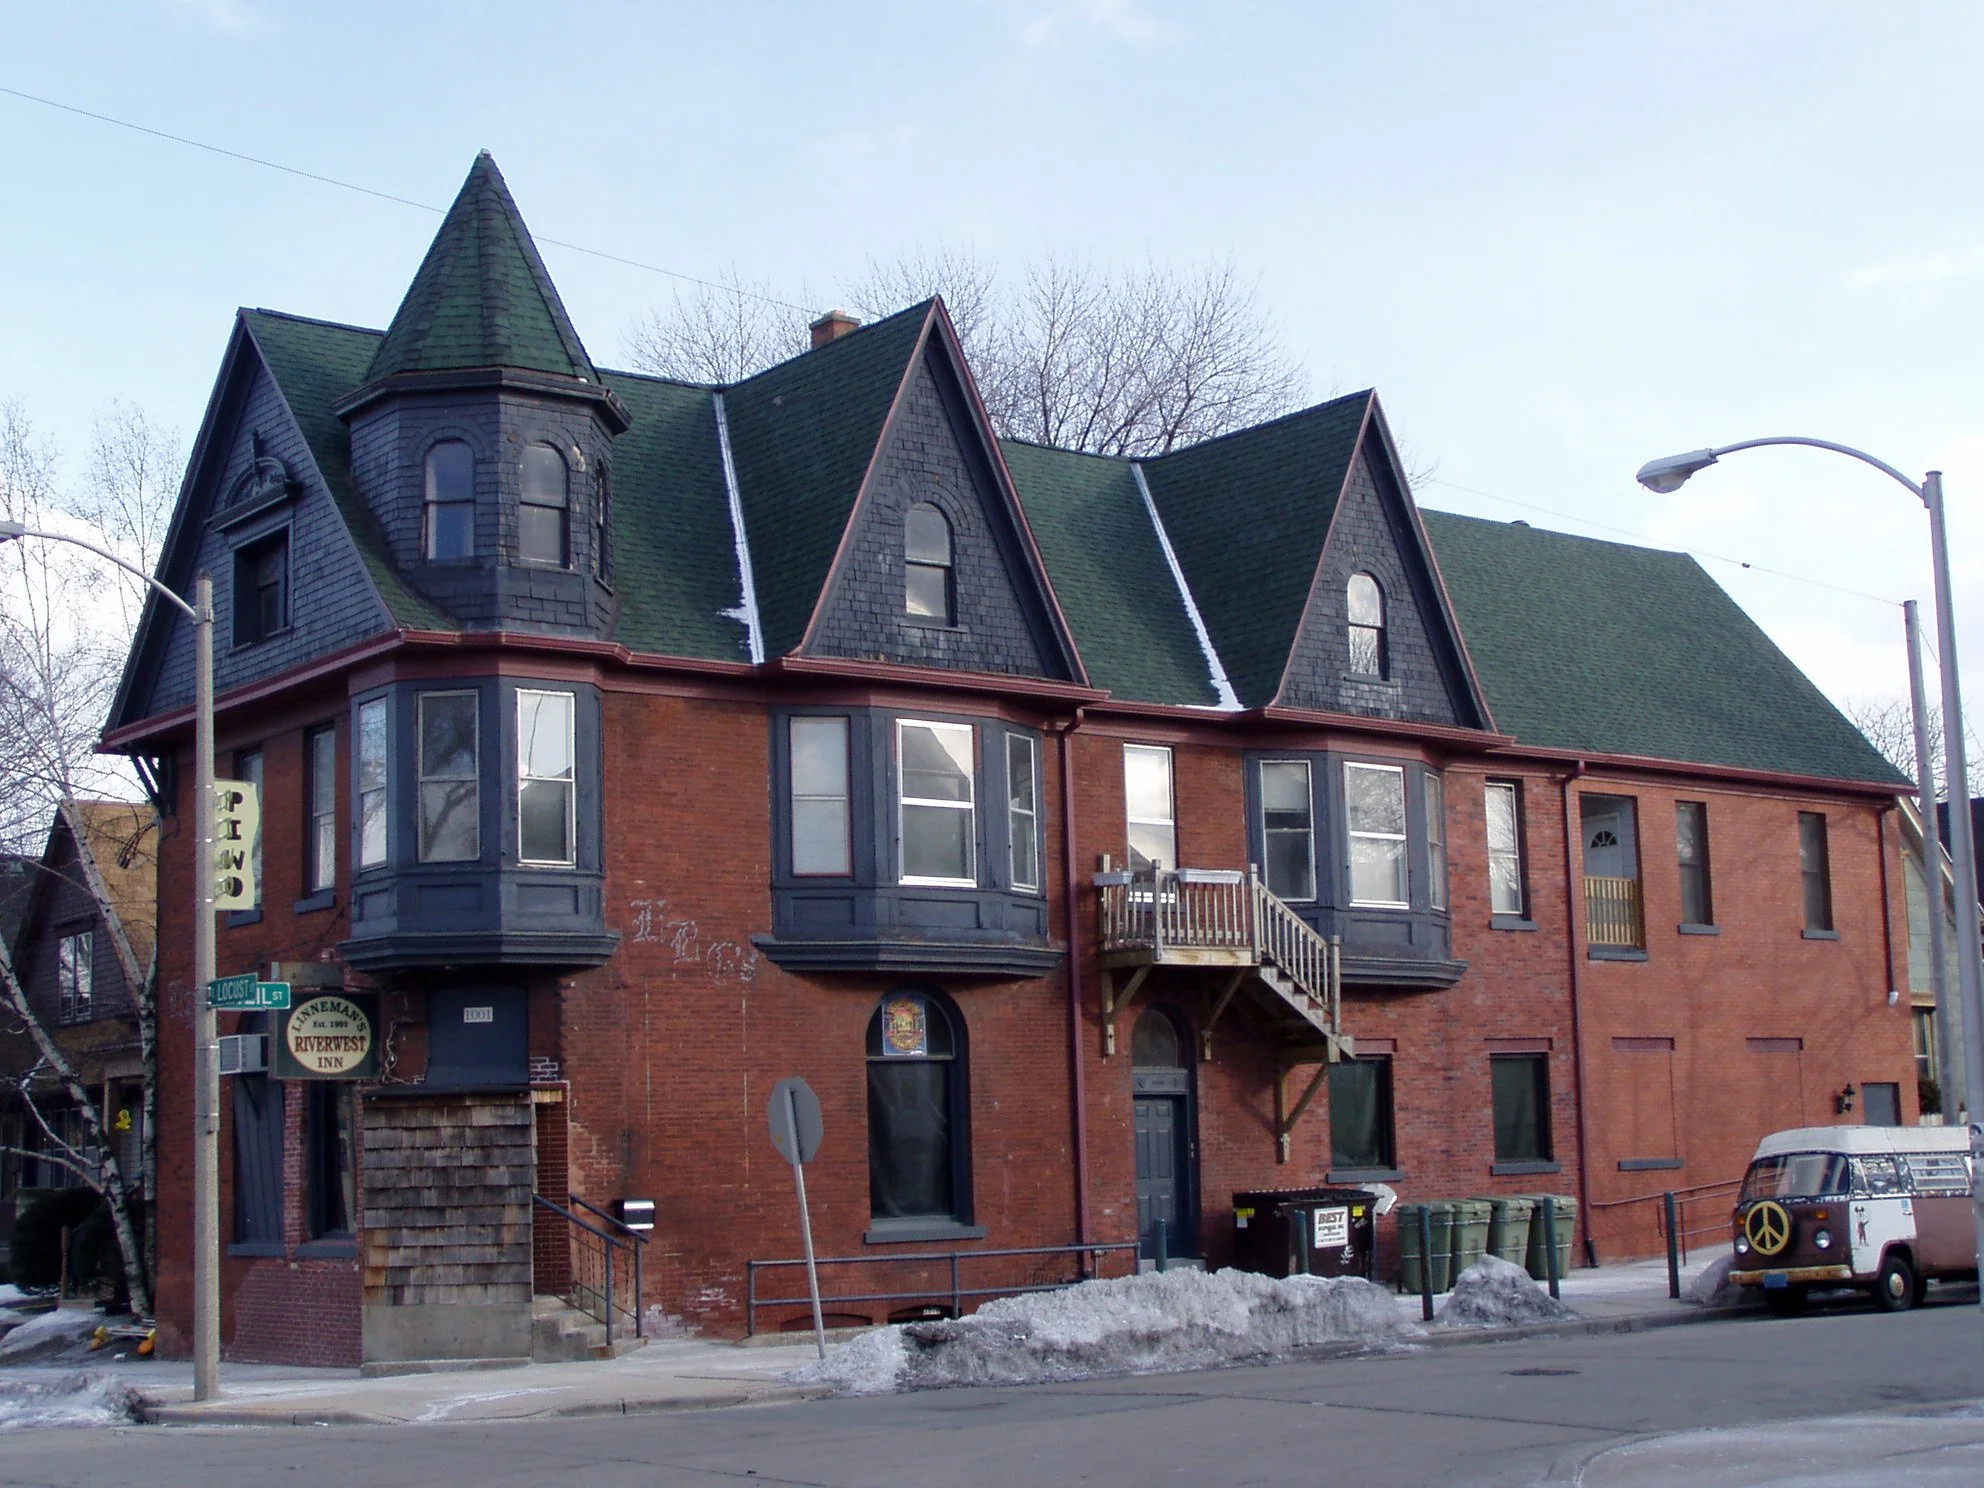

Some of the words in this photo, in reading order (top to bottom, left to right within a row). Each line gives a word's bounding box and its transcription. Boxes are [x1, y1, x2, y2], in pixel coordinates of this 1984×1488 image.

[222, 790, 246, 898] PIWO
[217, 979, 250, 1002] LOCUST
[272, 991, 283, 1000] ST
[292, 1000, 367, 1032] LINNEMAN'S
[466, 1009, 491, 1021] 1001
[295, 1035, 367, 1052] RIVERWEST
[317, 1056, 344, 1068] INN
[1318, 1211, 1345, 1225] BEST
